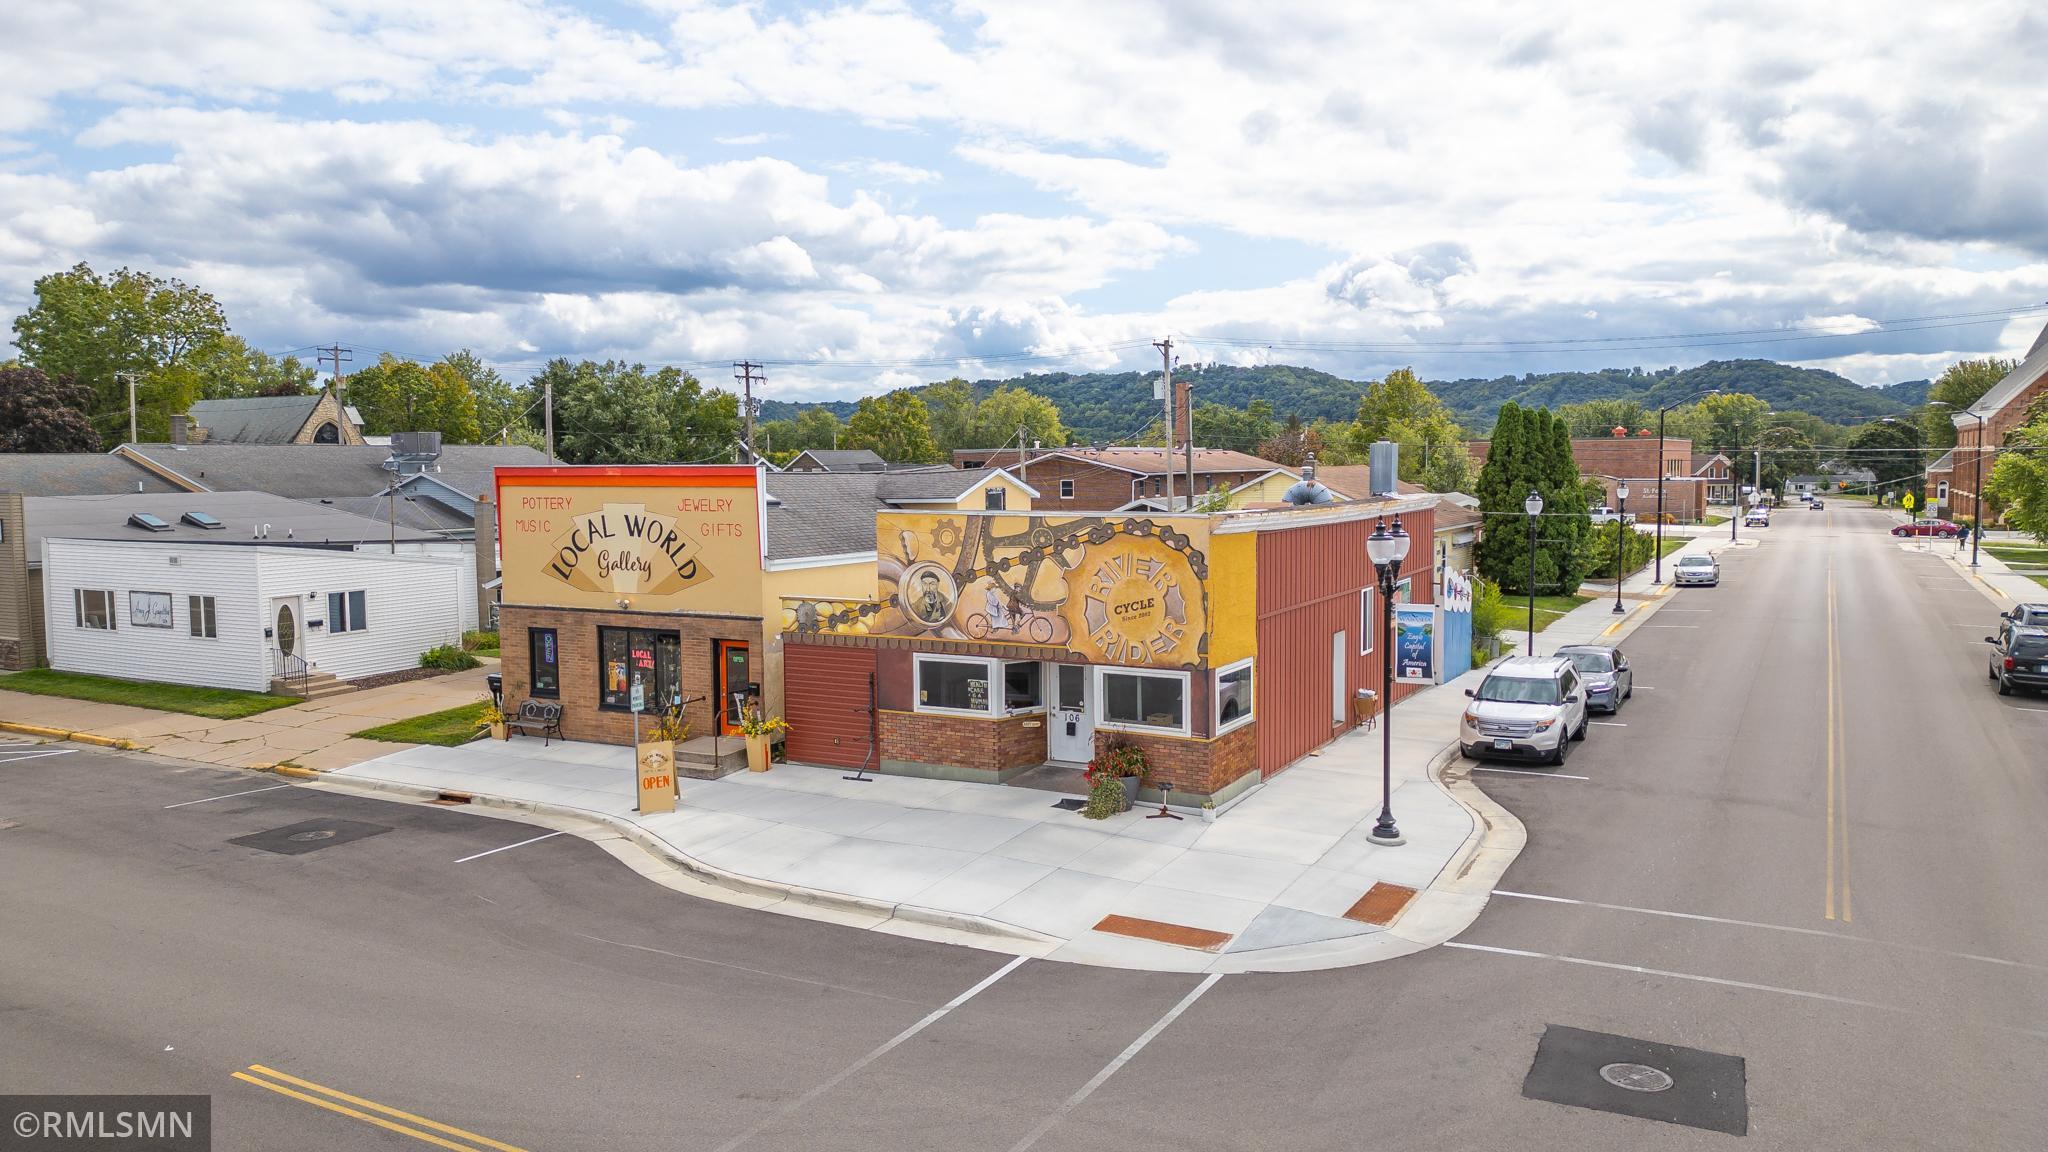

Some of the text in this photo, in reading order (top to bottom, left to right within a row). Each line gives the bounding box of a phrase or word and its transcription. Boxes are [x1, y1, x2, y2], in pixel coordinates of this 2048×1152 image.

[522, 497, 573, 510] POTTERY
[678, 498, 733, 513] JEWELRY
[515, 519, 551, 533] MUSIC
[701, 522, 743, 537] GIFTS
[551, 514, 697, 581] LOCAL WORLD
[597, 549, 652, 582] Gallery
[1114, 597, 1155, 615] CYCLE
[1407, 632, 1424, 643] Eagle
[631, 649, 652, 659] LOCAL
[1411, 650, 1419, 659] of
[1402, 659, 1426, 667] America
[1064, 713, 1080, 722] 106
[642, 775, 670, 790] OPEN
